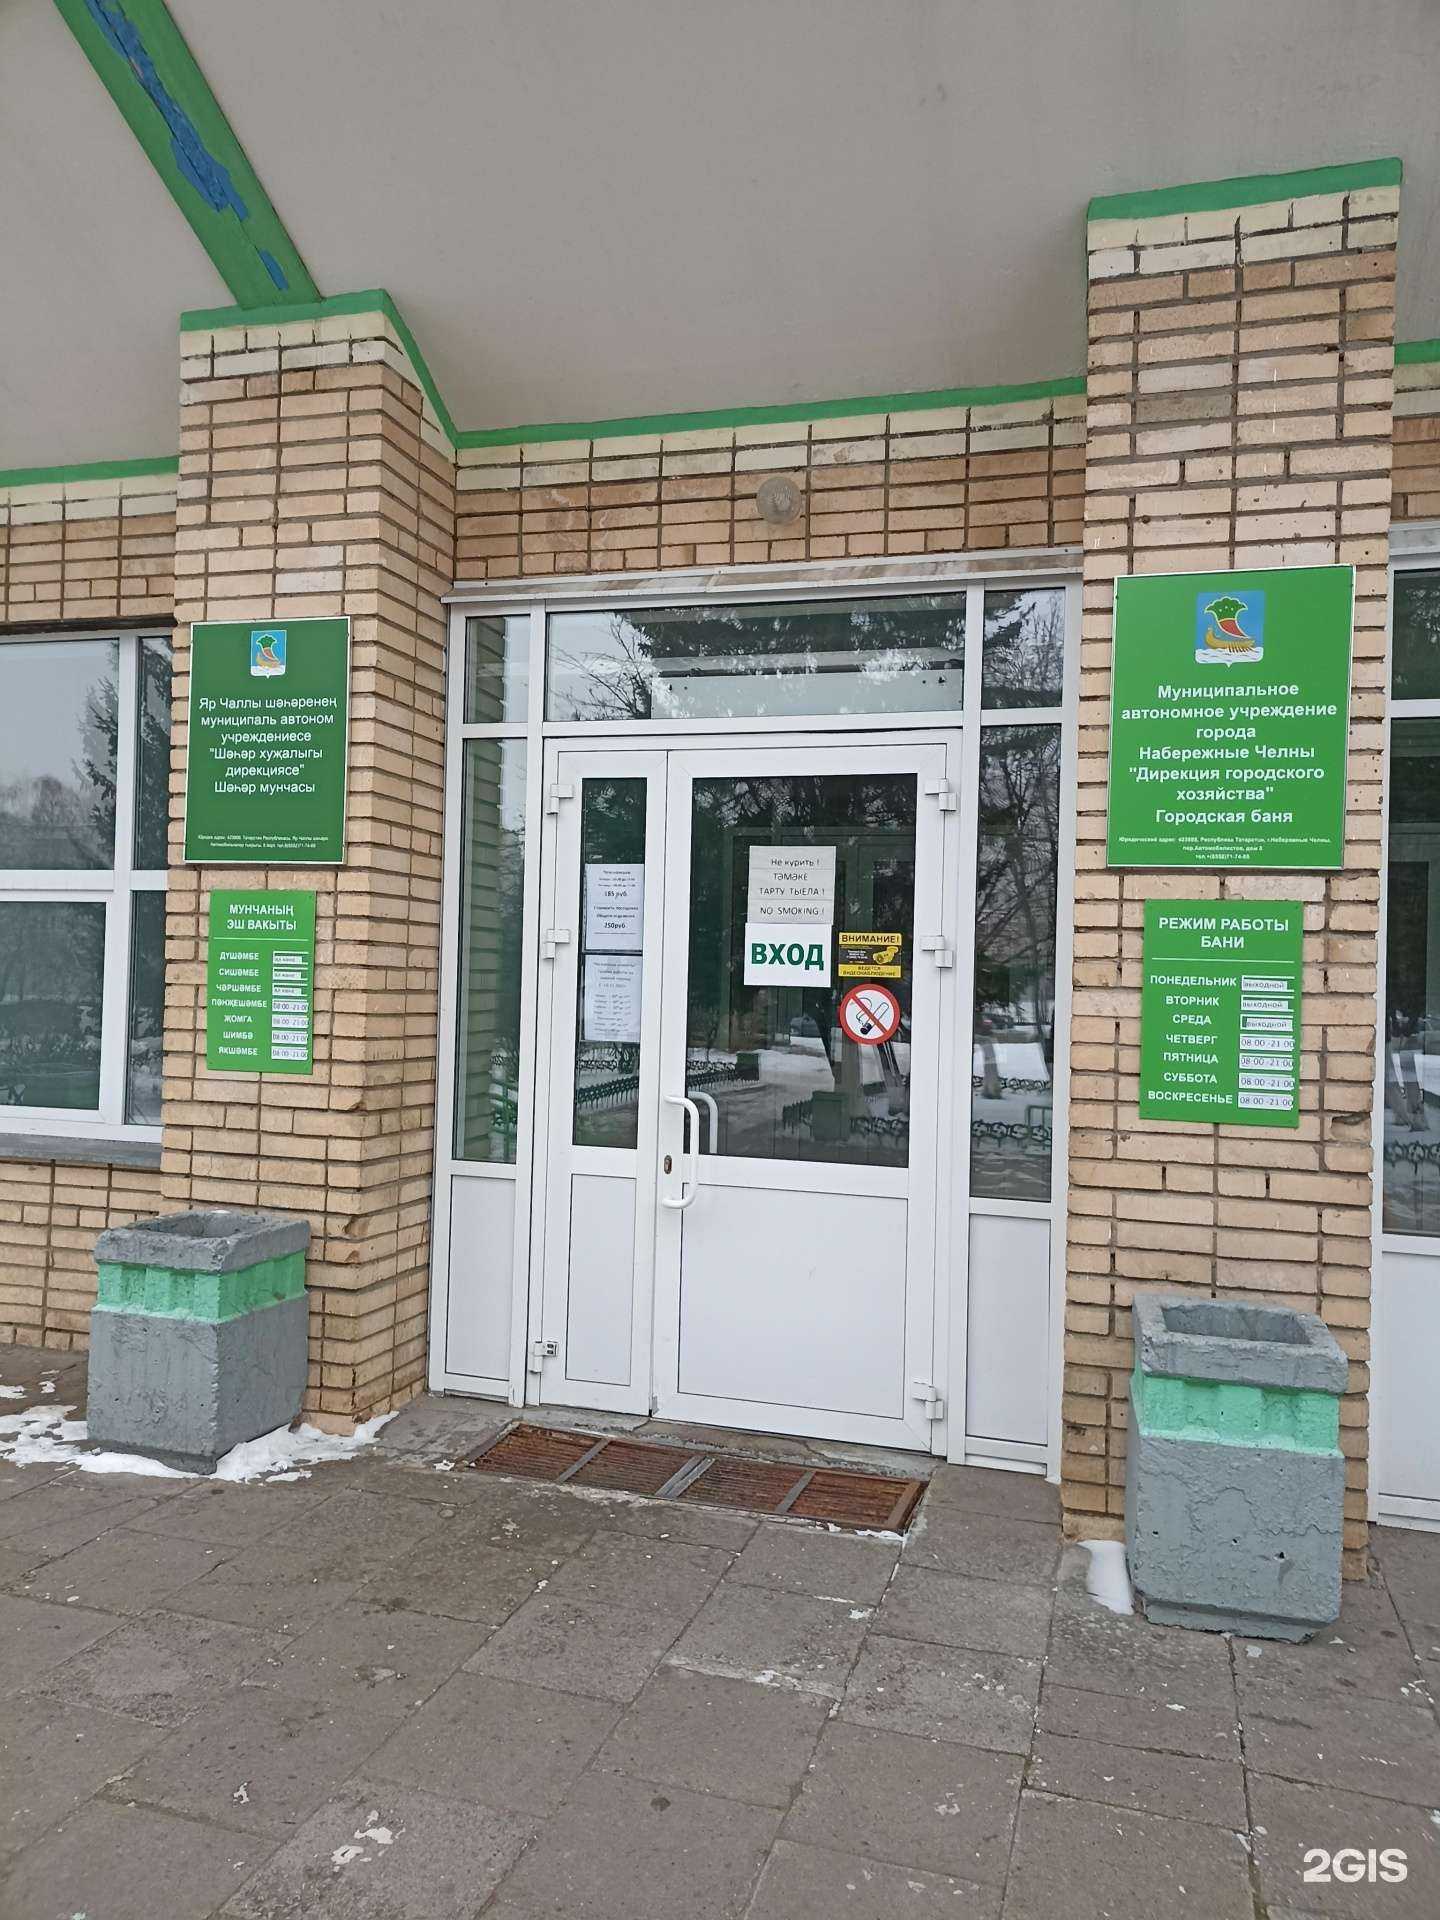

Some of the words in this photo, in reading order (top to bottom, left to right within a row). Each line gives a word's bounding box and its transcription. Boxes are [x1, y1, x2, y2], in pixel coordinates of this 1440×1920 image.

[1157, 684, 1299, 701] Муниципальное
[199, 697, 216, 711] Яр
[220, 697, 261, 709] Чаллы
[265, 697, 337, 710] шәһәренең
[1121, 706, 1224, 720] автономное
[1229, 703, 1337, 720] учреждение
[201, 715, 277, 728] муниципаль
[280, 714, 334, 725] автоном
[221, 732, 312, 745] учреждениесе
[1196, 727, 1256, 741] города
[210, 747, 256, 761] "Шәһәр
[1139, 746, 1249, 762] Набережные
[1254, 744, 1315, 759] Челны
[225, 764, 304, 778] дирекциясе"
[1129, 766, 1220, 782] "Дирекция
[1225, 767, 1324, 781] городского
[214, 781, 256, 795] Шәһәр
[260, 783, 315, 795] мунчасы
[1176, 786, 1274, 801] хозяйства"
[1155, 809, 1245, 825] Городская
[1251, 809, 1293, 823] баня
[784, 859, 814, 868] курить
[760, 887, 785, 895] ТАРТУ
[790, 887, 819, 896] ТЫЕЛА
[229, 904, 294, 917] МУНЧАНЫҢ
[760, 906, 774, 915] NO
[777, 906, 819, 915] SMOKING
[227, 919, 245, 930] ЭШ
[248, 919, 297, 931] ВАКЫТЫ
[1158, 917, 1216, 930] РЕЖИМ
[1220, 918, 1289, 931] РАБОТЫ
[841, 934, 900, 943] ВНИМАНИЕ!
[1200, 936, 1245, 948] БАНИ
[751, 943, 825, 971] ВХОД
[1150, 975, 1237, 987] ПОНЕДЕЛЬНИК
[1165, 995, 1220, 1006] ВТОРНИК
[1172, 1014, 1212, 1025] СРЕДА
[1166, 1034, 1219, 1045] ЧЕТВЕРГ
[1163, 1052, 1218, 1064] ПЯТНИЦА
[1163, 1072, 1217, 1084] СУББОТА
[1148, 1090, 1233, 1104] ВОСКРЕСЕНЬЕ
